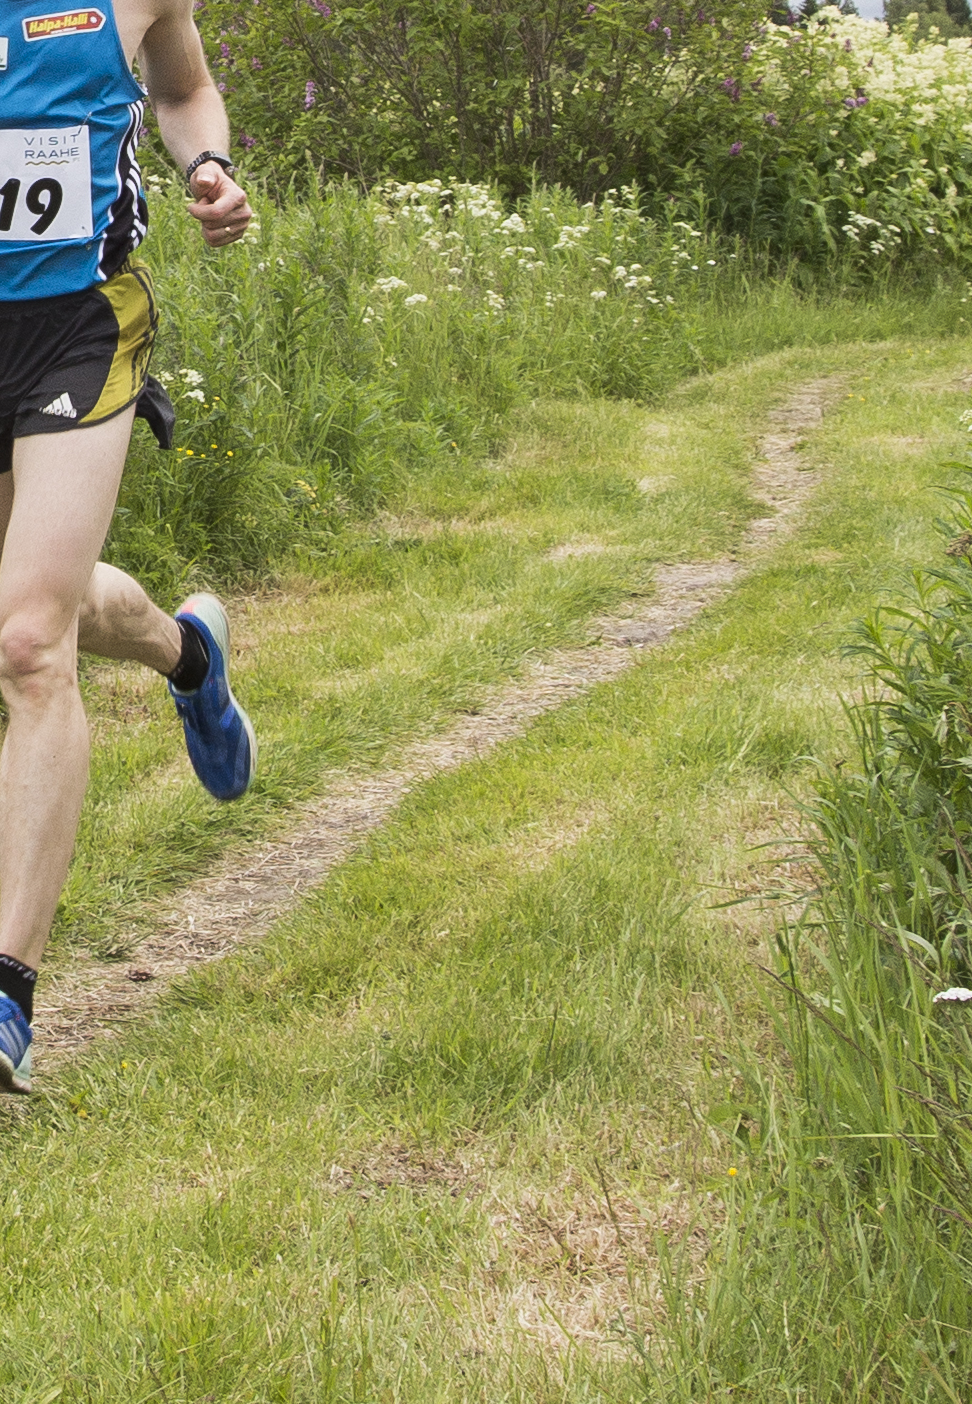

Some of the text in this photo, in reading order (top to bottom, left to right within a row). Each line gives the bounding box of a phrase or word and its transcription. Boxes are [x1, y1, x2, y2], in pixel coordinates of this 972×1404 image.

[29, 12, 88, 33] Halpa-Halli
[24, 135, 80, 146] VISIT
[24, 147, 80, 159] RAAHE
